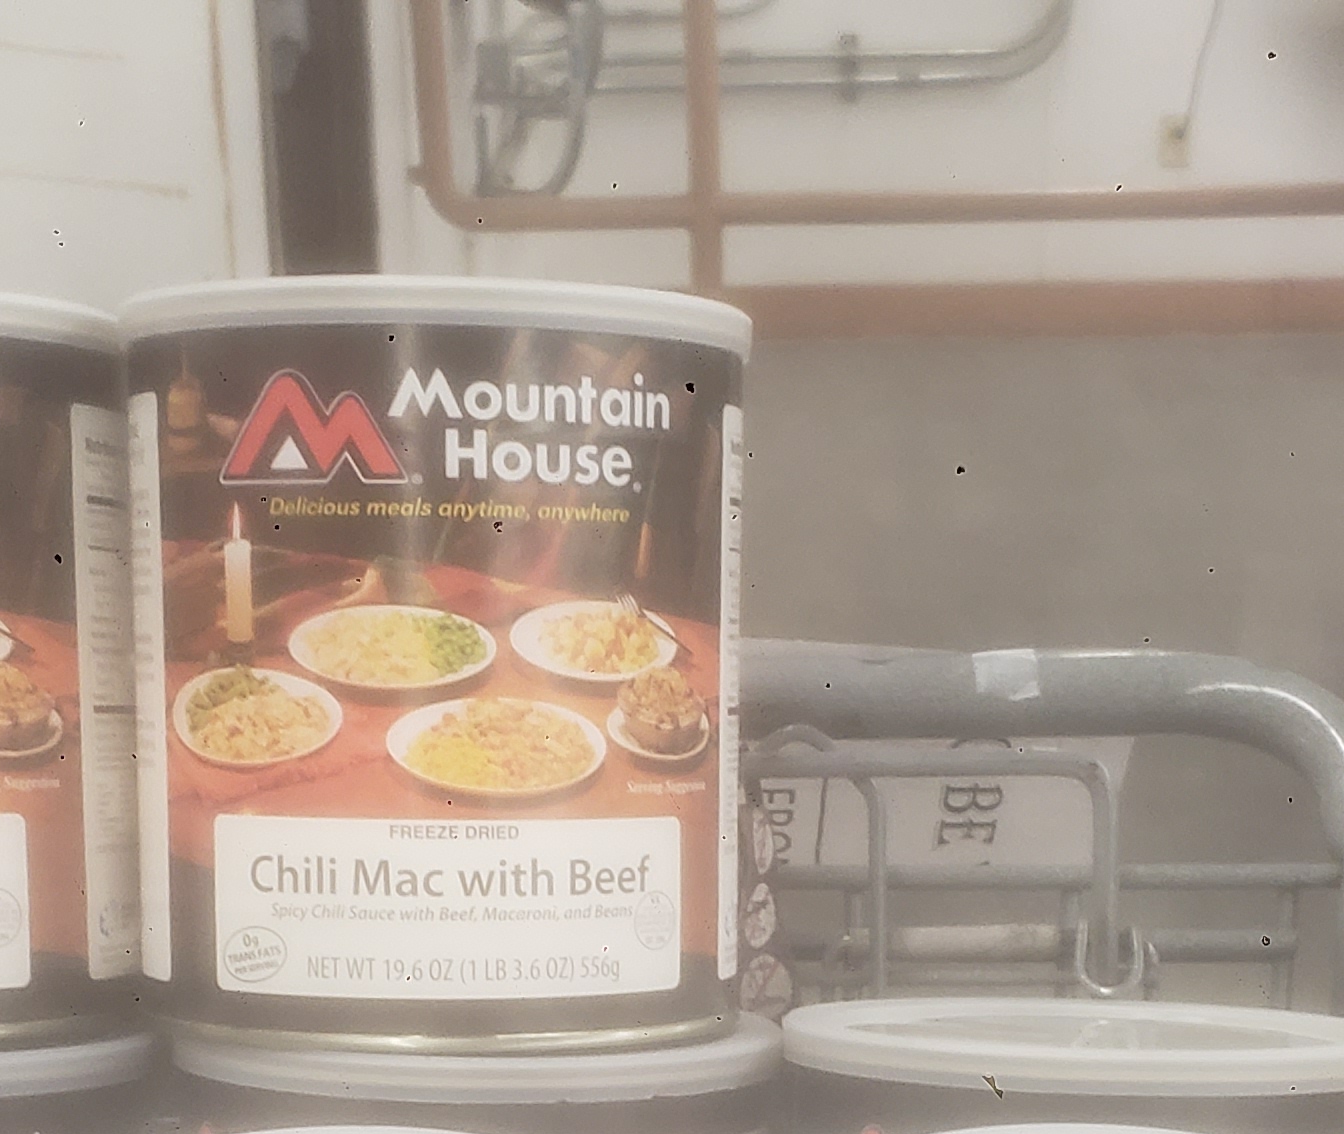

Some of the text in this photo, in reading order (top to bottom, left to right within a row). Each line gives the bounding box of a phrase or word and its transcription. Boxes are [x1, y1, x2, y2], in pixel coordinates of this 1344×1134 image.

[387, 367, 671, 431] Mountain
[444, 428, 635, 487] House
[268, 496, 631, 524] Delicious meals anytime, anywhere
[389, 824, 520, 840] FREEZE DRIED
[249, 854, 651, 898] Chili Mac with Beef
[272, 902, 634, 922] Spicy Chili Sauce with Beef, Macaroni, and Beans
[307, 955, 620, 984] NET WT 19.6 OZ (1 LB 3.6 OZ) 556g
